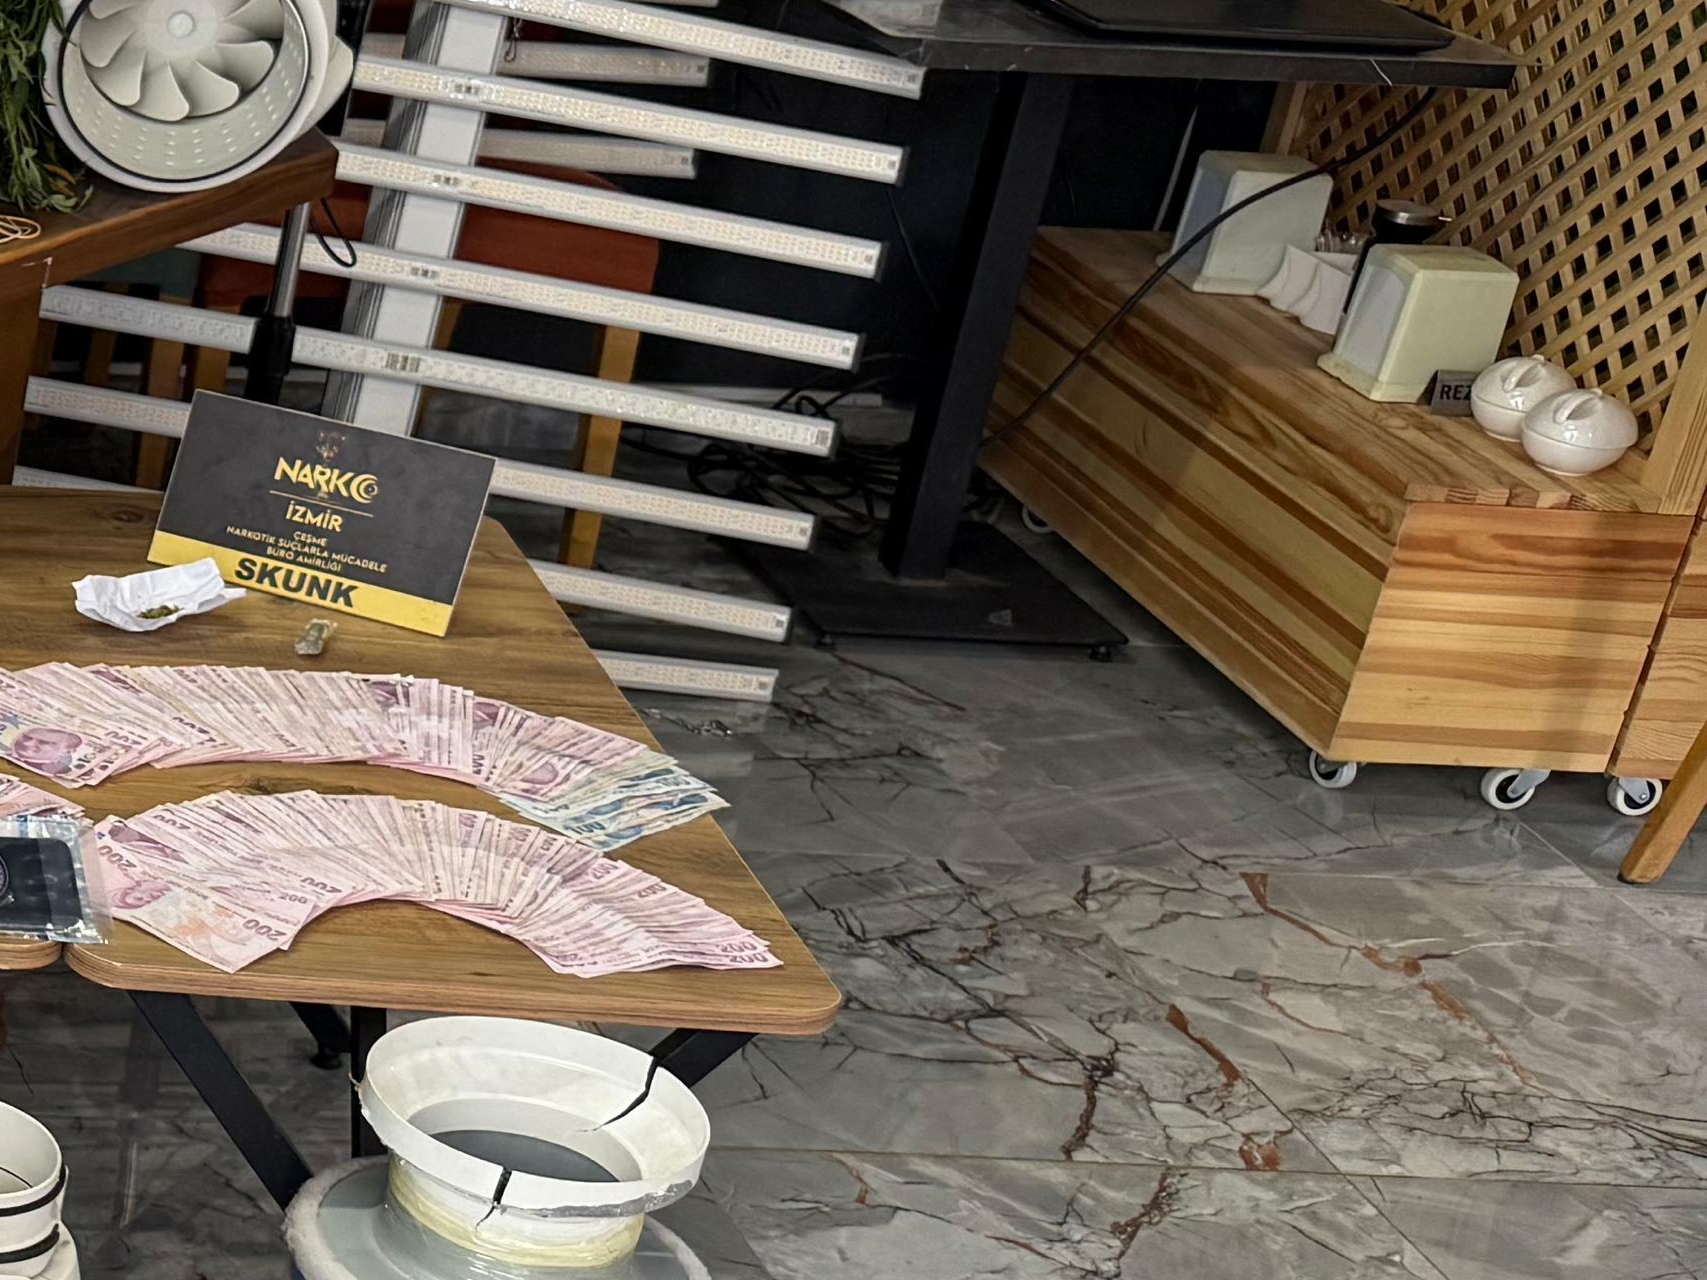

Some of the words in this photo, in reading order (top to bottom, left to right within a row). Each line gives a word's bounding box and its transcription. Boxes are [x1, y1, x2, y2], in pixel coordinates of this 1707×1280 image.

[274, 457, 378, 504] NARKO
[286, 500, 343, 533] İZMİR
[234, 557, 359, 608] SKUNK
[279, 892, 308, 905] 200
[243, 919, 288, 941] 200
